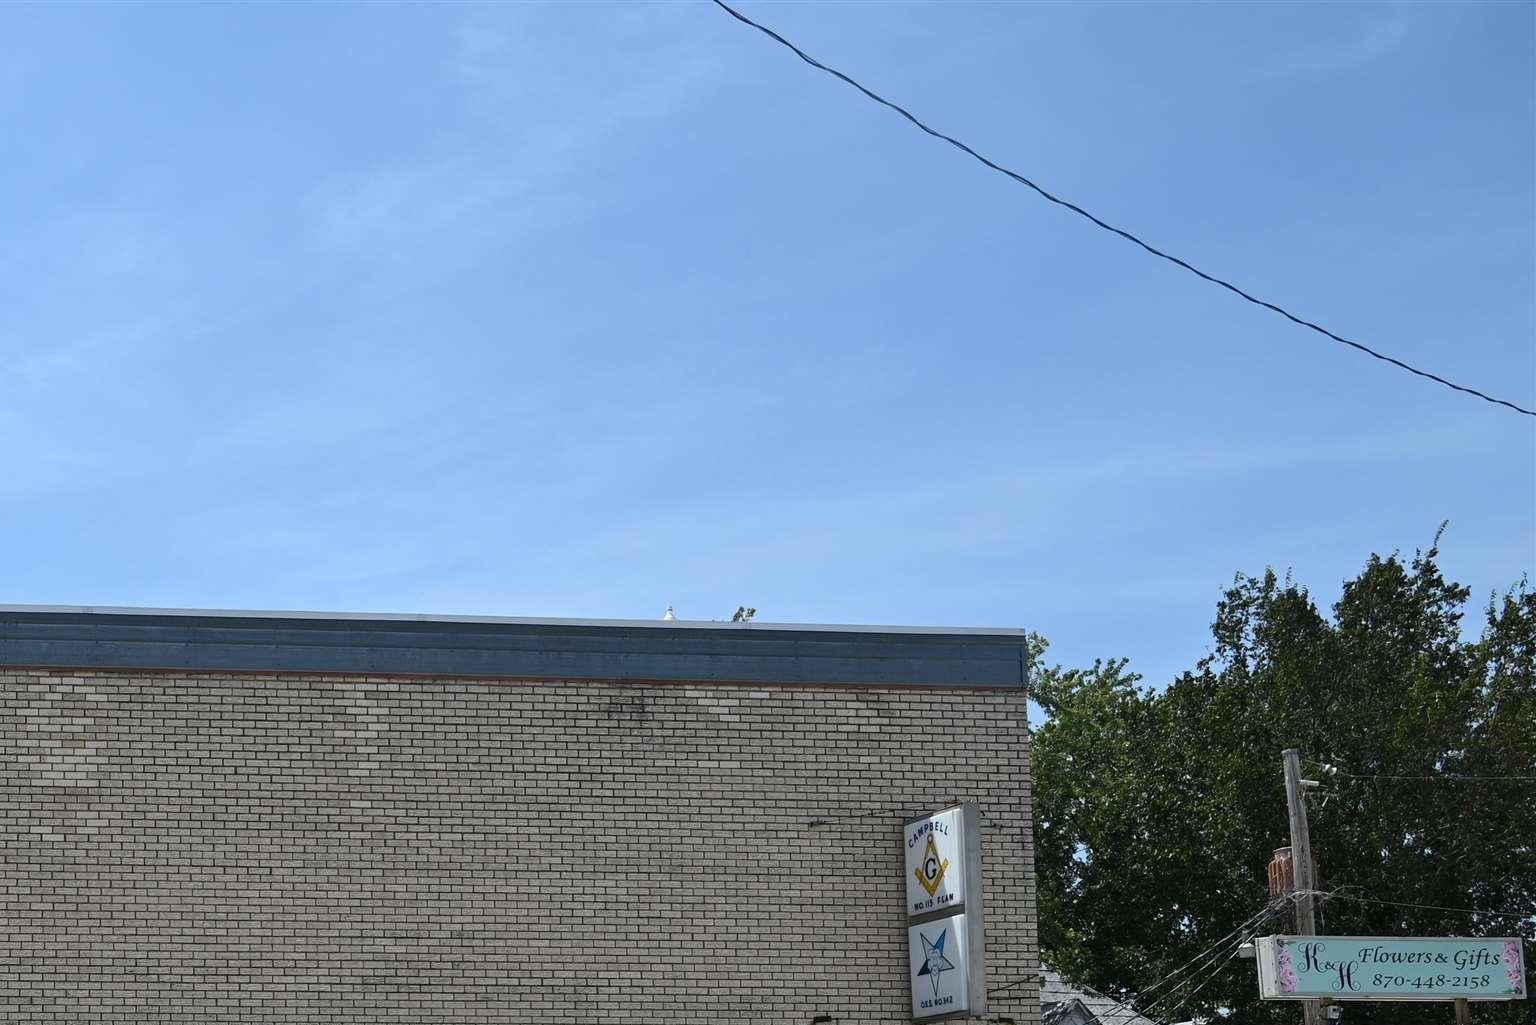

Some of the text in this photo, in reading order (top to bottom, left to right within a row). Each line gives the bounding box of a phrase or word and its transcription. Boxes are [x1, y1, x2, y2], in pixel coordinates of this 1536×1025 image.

[908, 821, 949, 848] CAMPBELL
[925, 858, 937, 880] G
[1358, 946, 1501, 971] Flowers & Gifts
[1372, 974, 1490, 990] 870-448-2158
